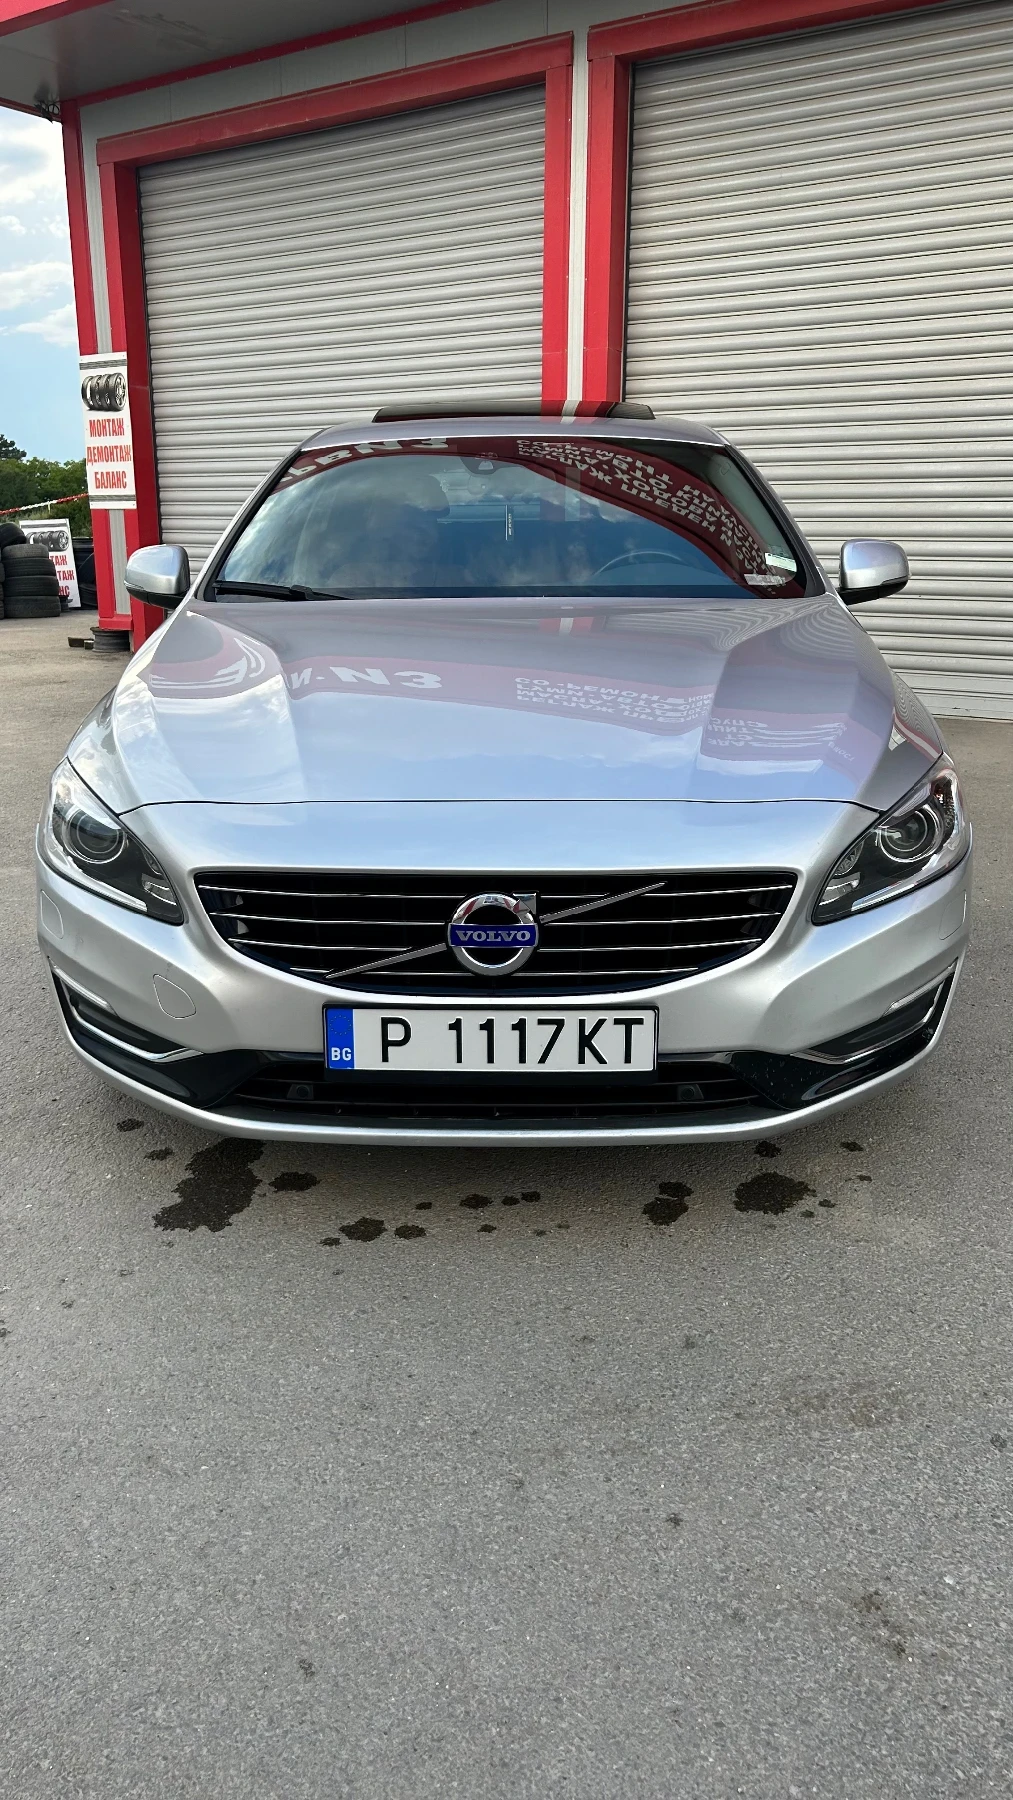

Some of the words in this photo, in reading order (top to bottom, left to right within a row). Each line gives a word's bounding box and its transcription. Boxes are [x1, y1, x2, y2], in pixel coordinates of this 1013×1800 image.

[88, 418, 125, 438] МОНТАЖ
[86, 444, 132, 466] ДЕМОНТАЖ
[94, 470, 127, 489] БАЛАНС
[50, 554, 67, 566] ТАЖ
[455, 930, 531, 942] VOLVO
[331, 1048, 352, 1061] BG
[380, 1016, 412, 1063] P
